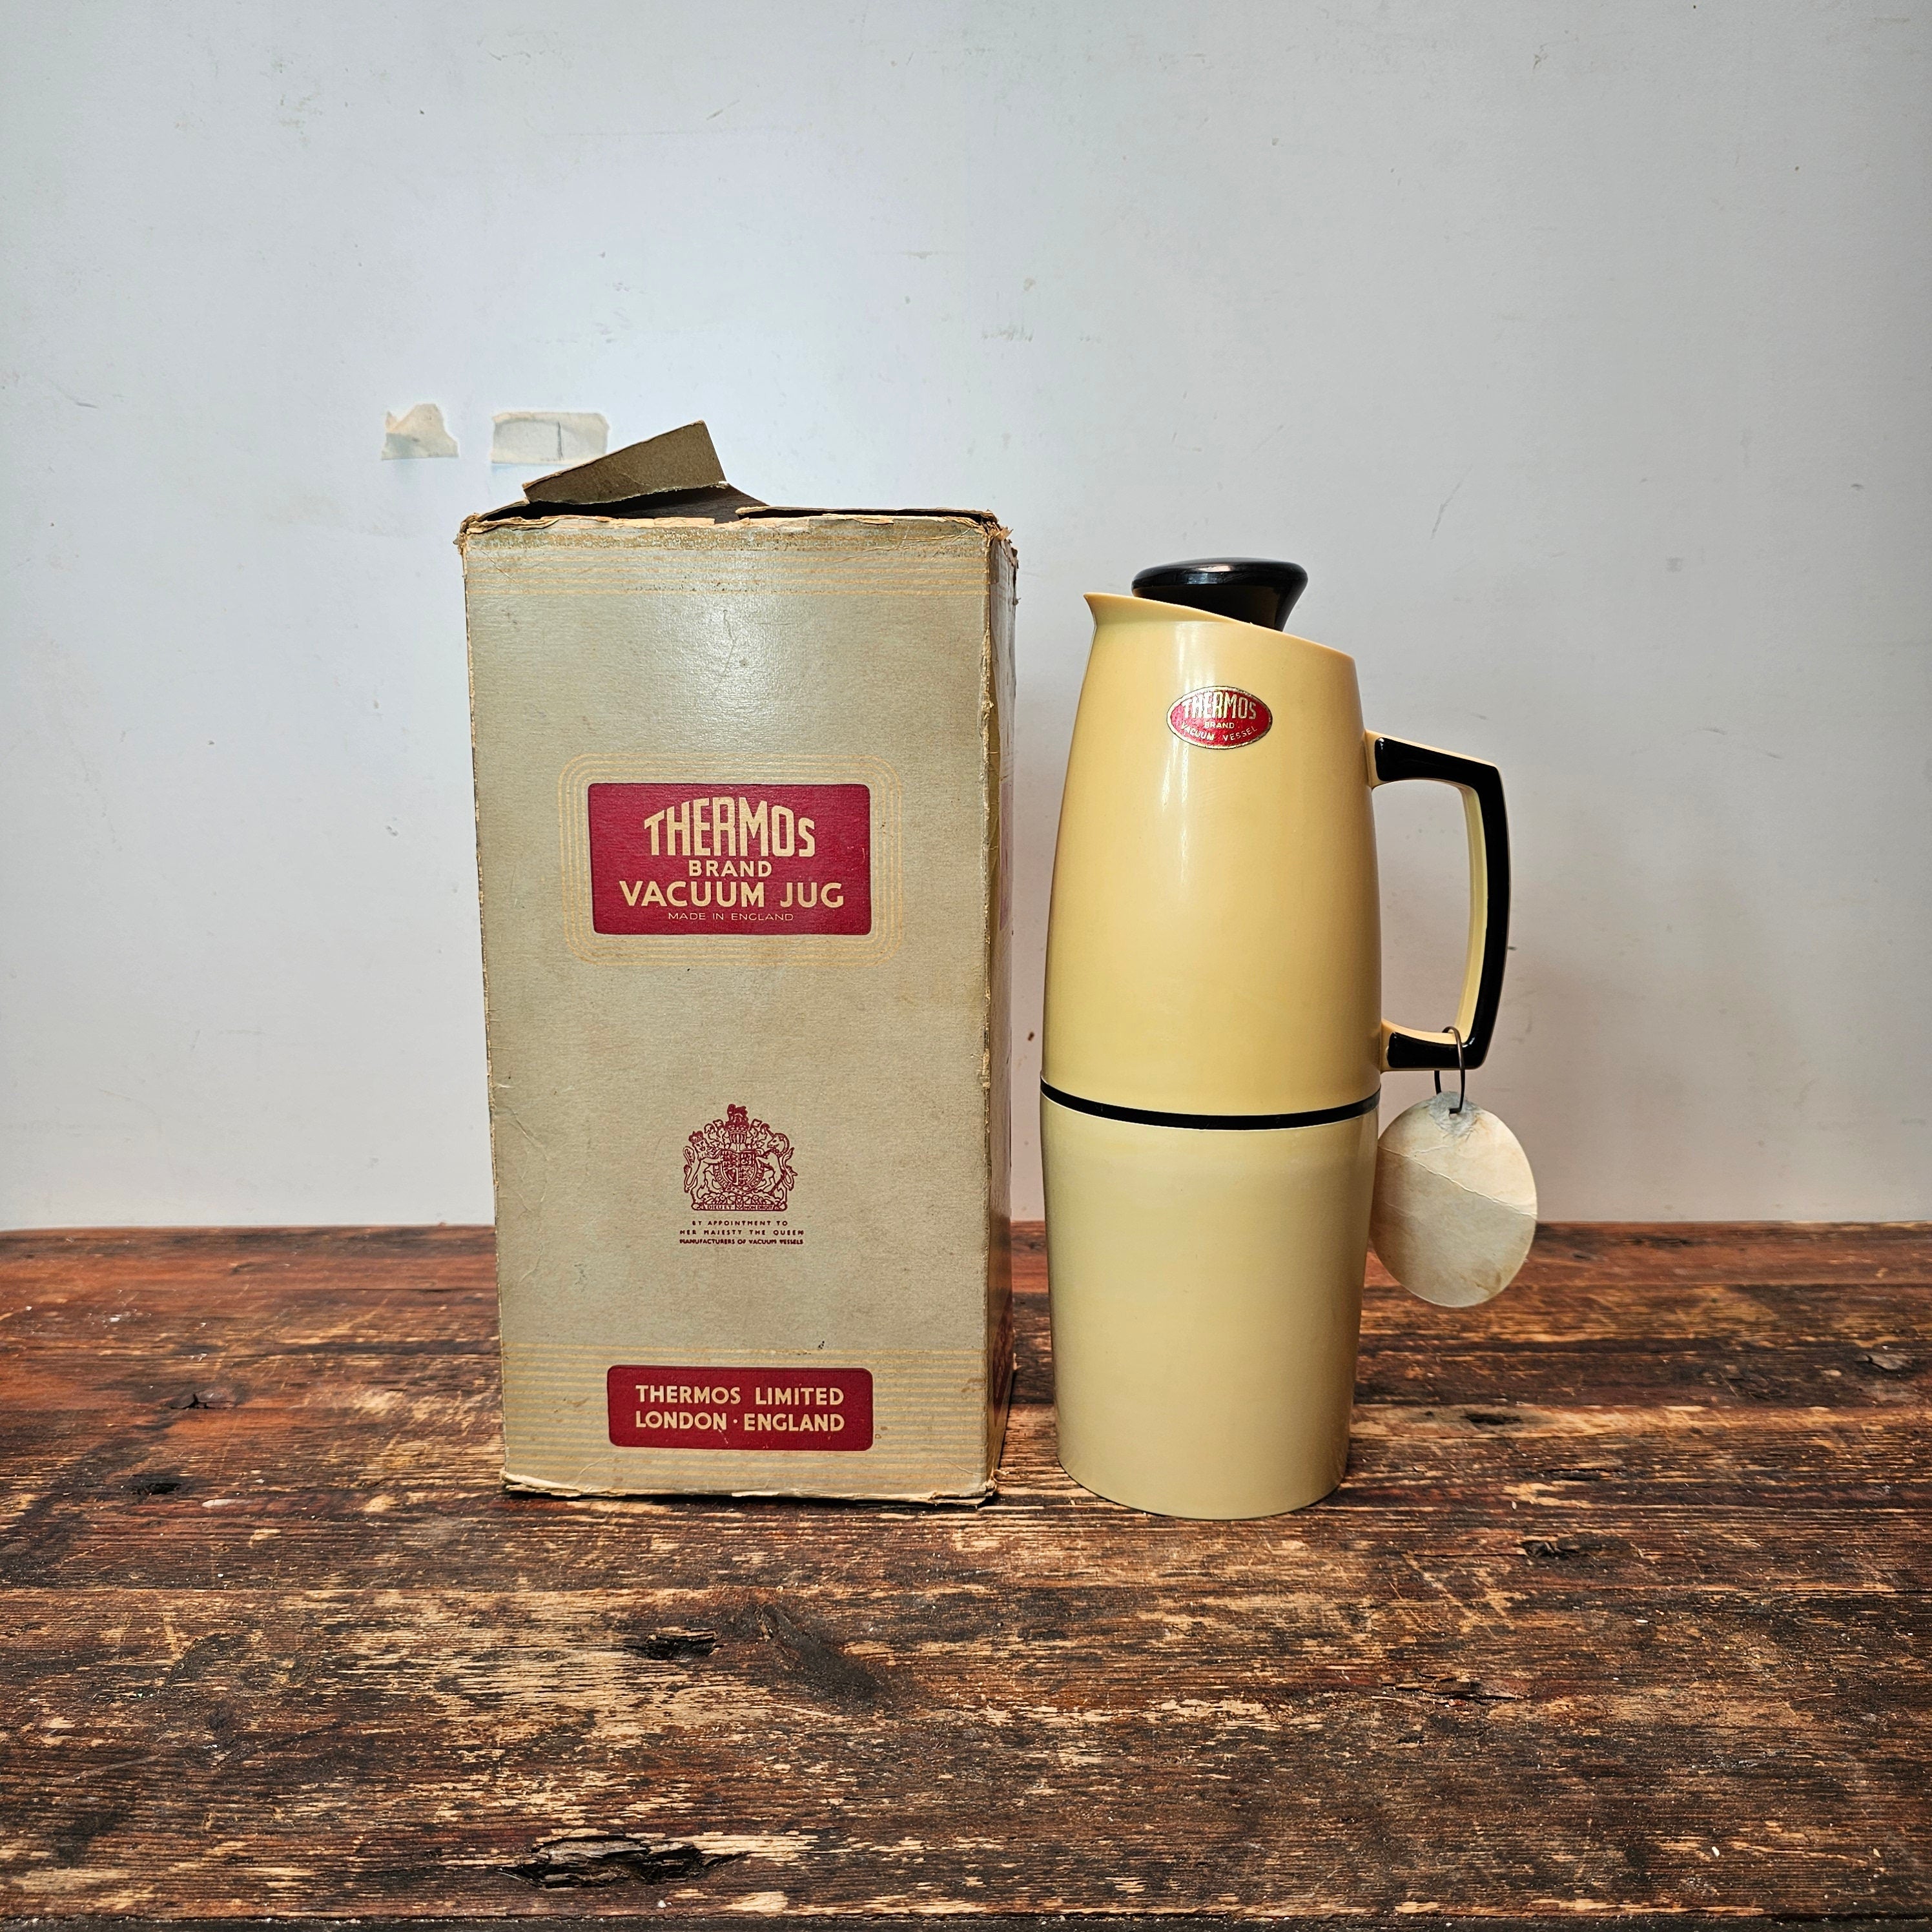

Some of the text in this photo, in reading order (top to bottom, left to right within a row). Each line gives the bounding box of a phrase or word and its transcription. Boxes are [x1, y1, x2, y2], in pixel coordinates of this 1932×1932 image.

[1182, 691, 1257, 719] THERMOS
[1181, 722, 1257, 741] VACUUM VESSEL
[644, 797, 815, 857] THERMOS
[688, 860, 772, 877] BRAND
[619, 881, 844, 908] VACUUM JUG
[668, 912, 706, 920] MADE
[731, 912, 794, 921] ENGLAND
[635, 1385, 844, 1405] THERMOS LIMITED
[636, 1411, 845, 1432] LONDON ENGLAND
